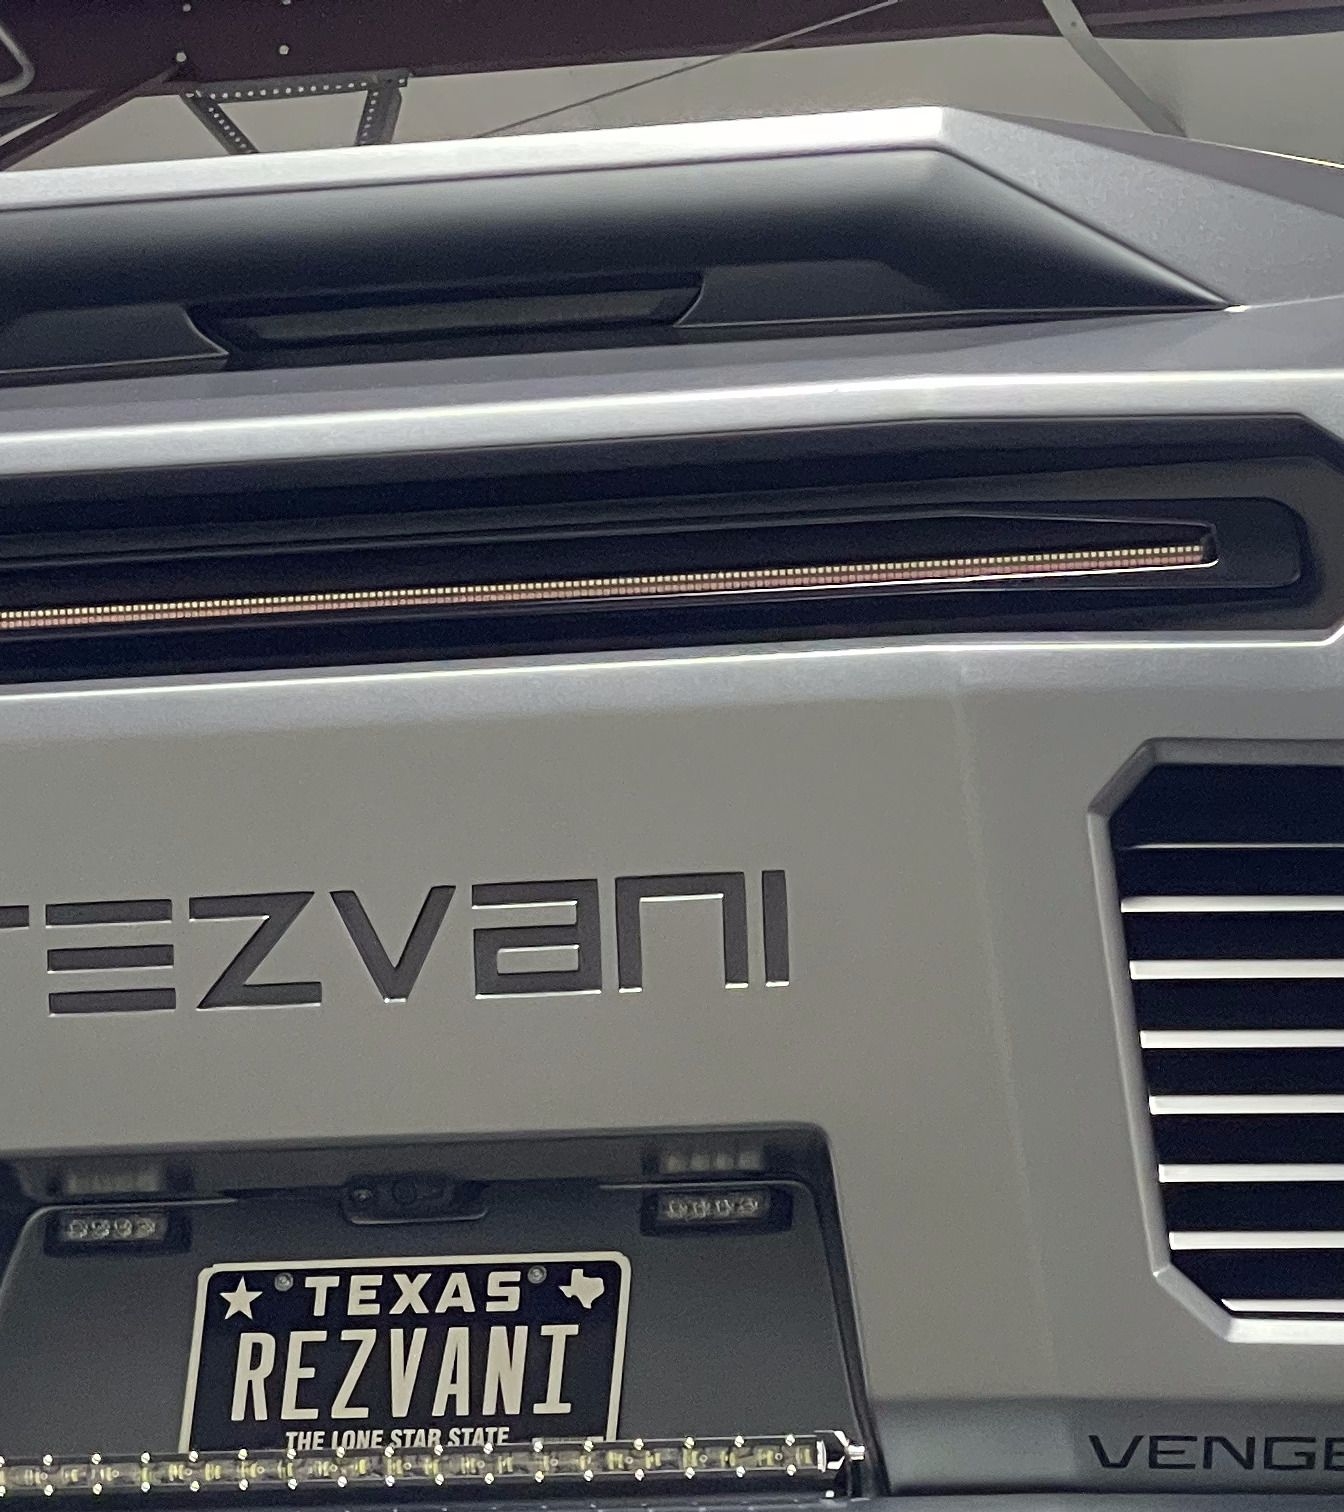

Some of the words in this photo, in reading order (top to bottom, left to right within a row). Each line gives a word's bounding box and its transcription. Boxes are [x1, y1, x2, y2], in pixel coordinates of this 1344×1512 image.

[304, 1270, 522, 1317] TEXAS
[230, 1323, 580, 1422] REZVANI
[286, 1431, 325, 1450] THE
[331, 1429, 384, 1450] LONE
[390, 1428, 442, 1448] STAR
[447, 1426, 510, 1447] STATE
